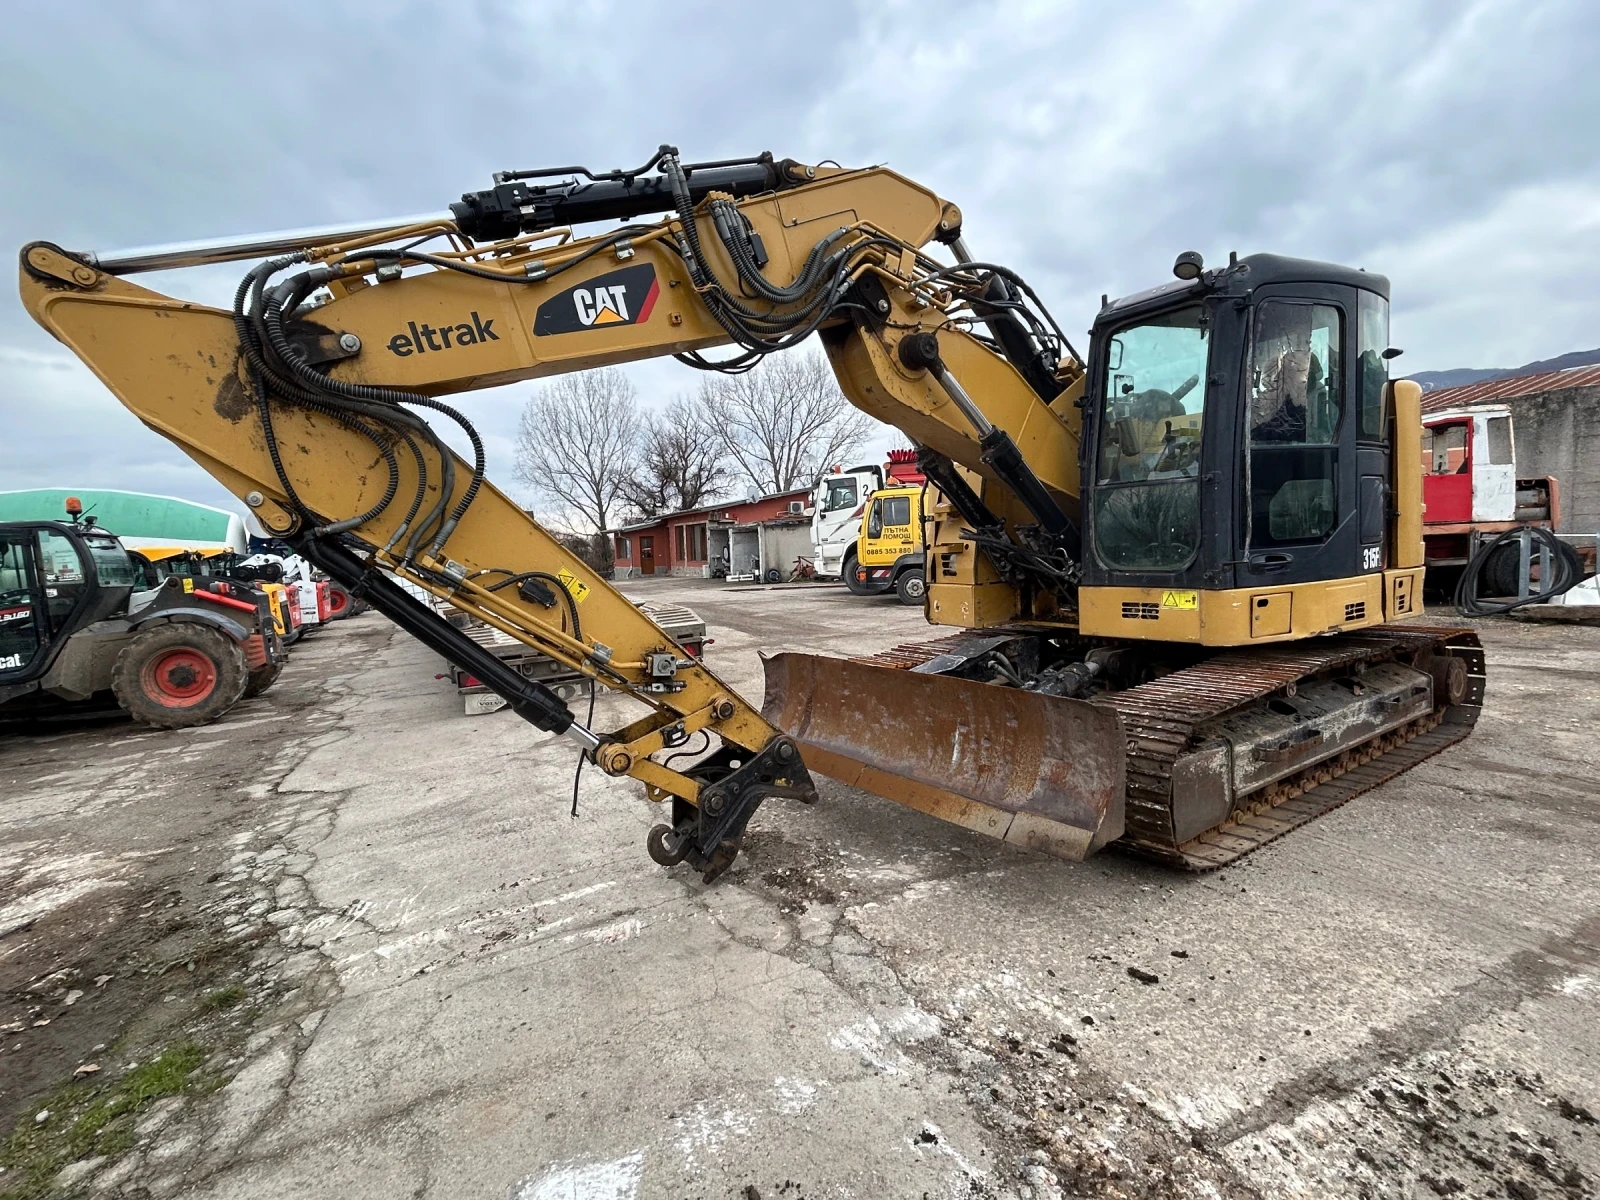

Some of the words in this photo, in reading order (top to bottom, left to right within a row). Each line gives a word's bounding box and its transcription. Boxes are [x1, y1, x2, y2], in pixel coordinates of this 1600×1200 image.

[573, 285, 630, 326] CAT
[387, 311, 500, 357] eltrak
[862, 484, 869, 496] 2
